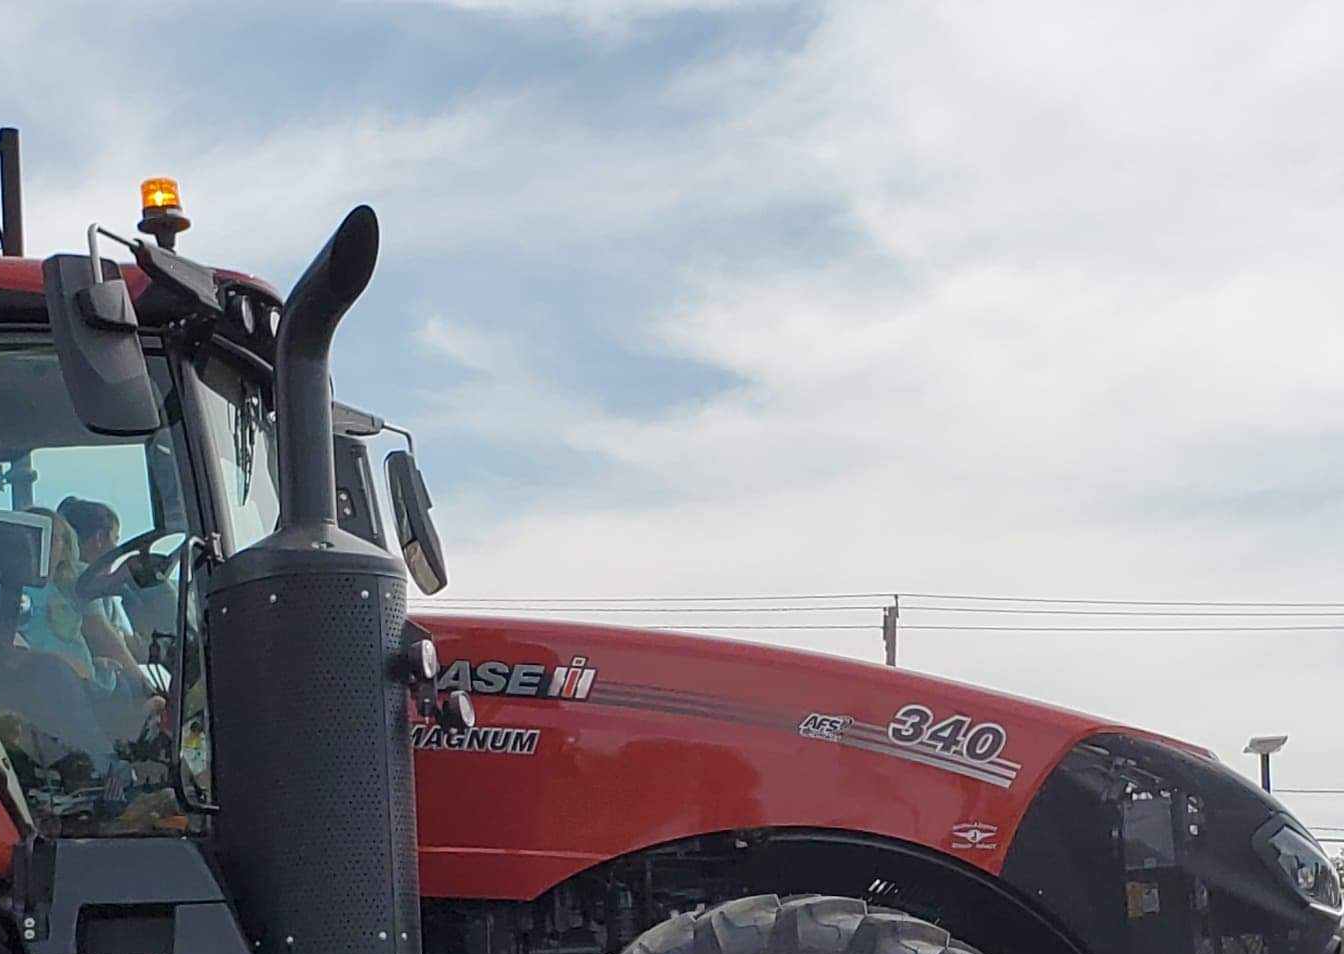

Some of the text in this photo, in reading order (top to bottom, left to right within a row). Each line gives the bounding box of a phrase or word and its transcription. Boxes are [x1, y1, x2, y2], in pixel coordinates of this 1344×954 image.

[434, 659, 546, 697] ASE
[801, 713, 843, 733] AFS
[888, 704, 1007, 764] 340
